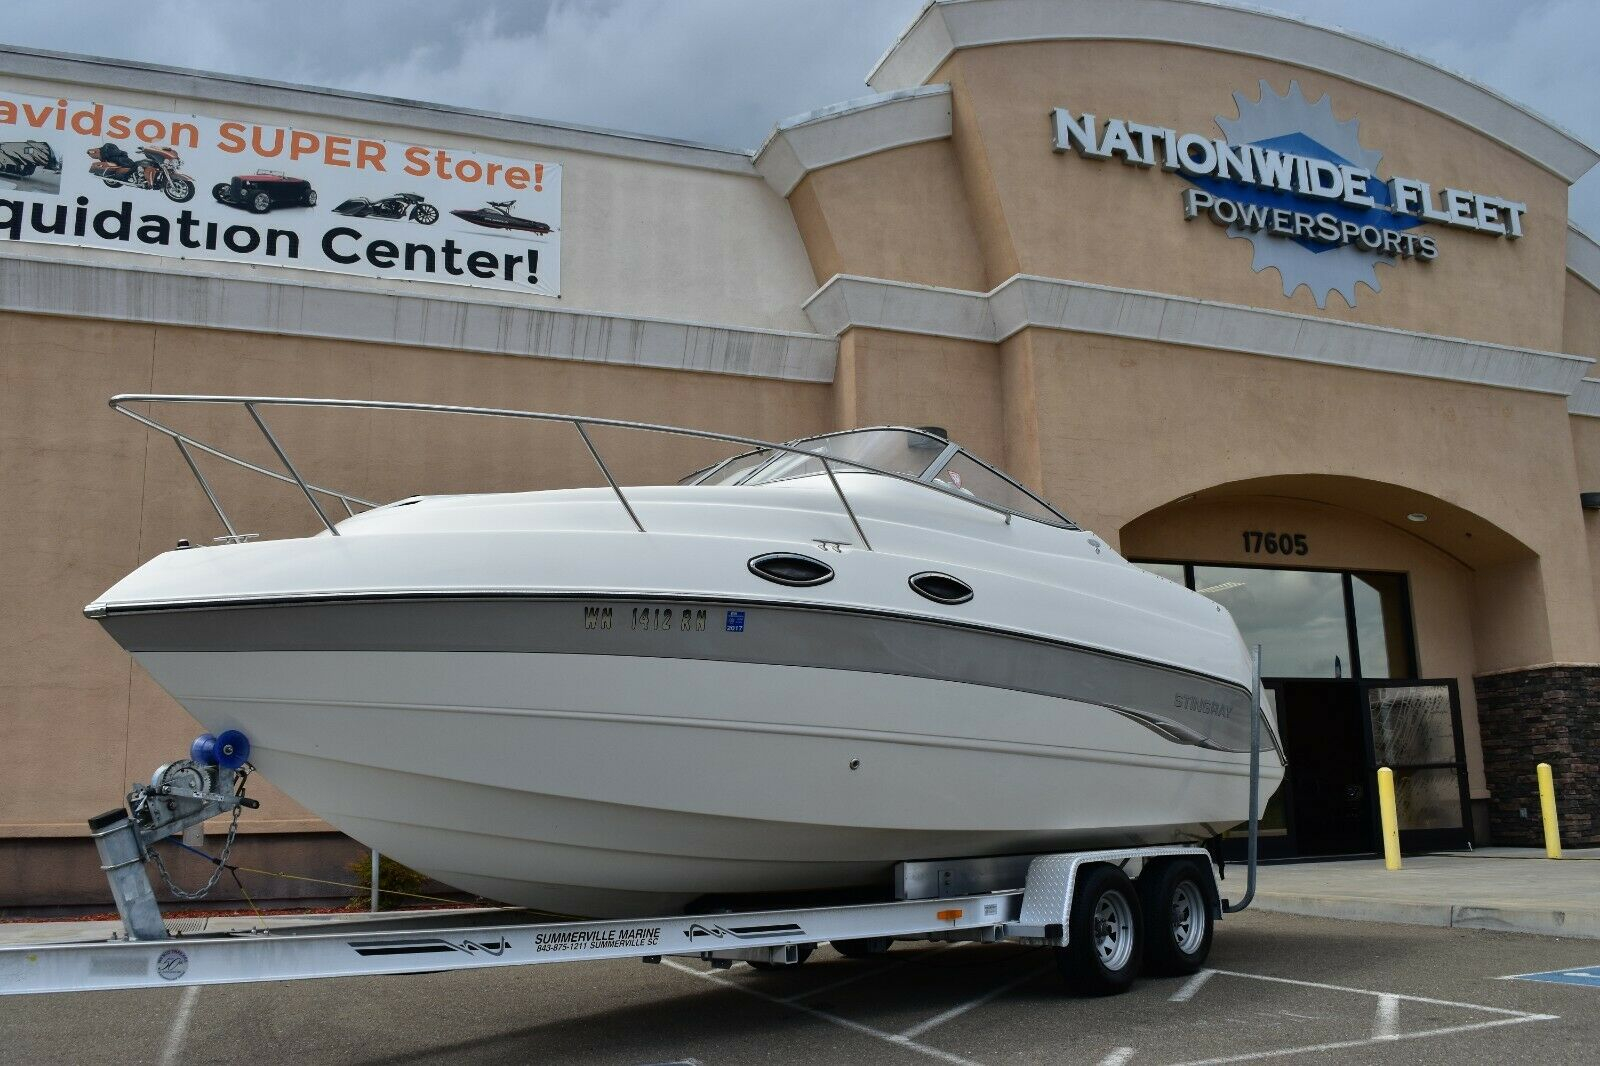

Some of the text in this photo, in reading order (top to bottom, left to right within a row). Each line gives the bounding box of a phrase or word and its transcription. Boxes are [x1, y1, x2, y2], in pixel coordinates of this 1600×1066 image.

[216, 121, 387, 173] SUPER
[402, 146, 544, 193] Store!
[1050, 107, 1526, 240] NATIONWIDE FLEET
[321, 226, 540, 285] Center!
[1242, 531, 1309, 556] 17605
[584, 606, 613, 630] WN
[681, 609, 707, 632] RN
[1174, 693, 1233, 719] STINGRAY
[535, 928, 661, 945] SUMMERVILLE MARINE
[536, 937, 659, 953] 843-875-1211 SUMMERVILLE SC
